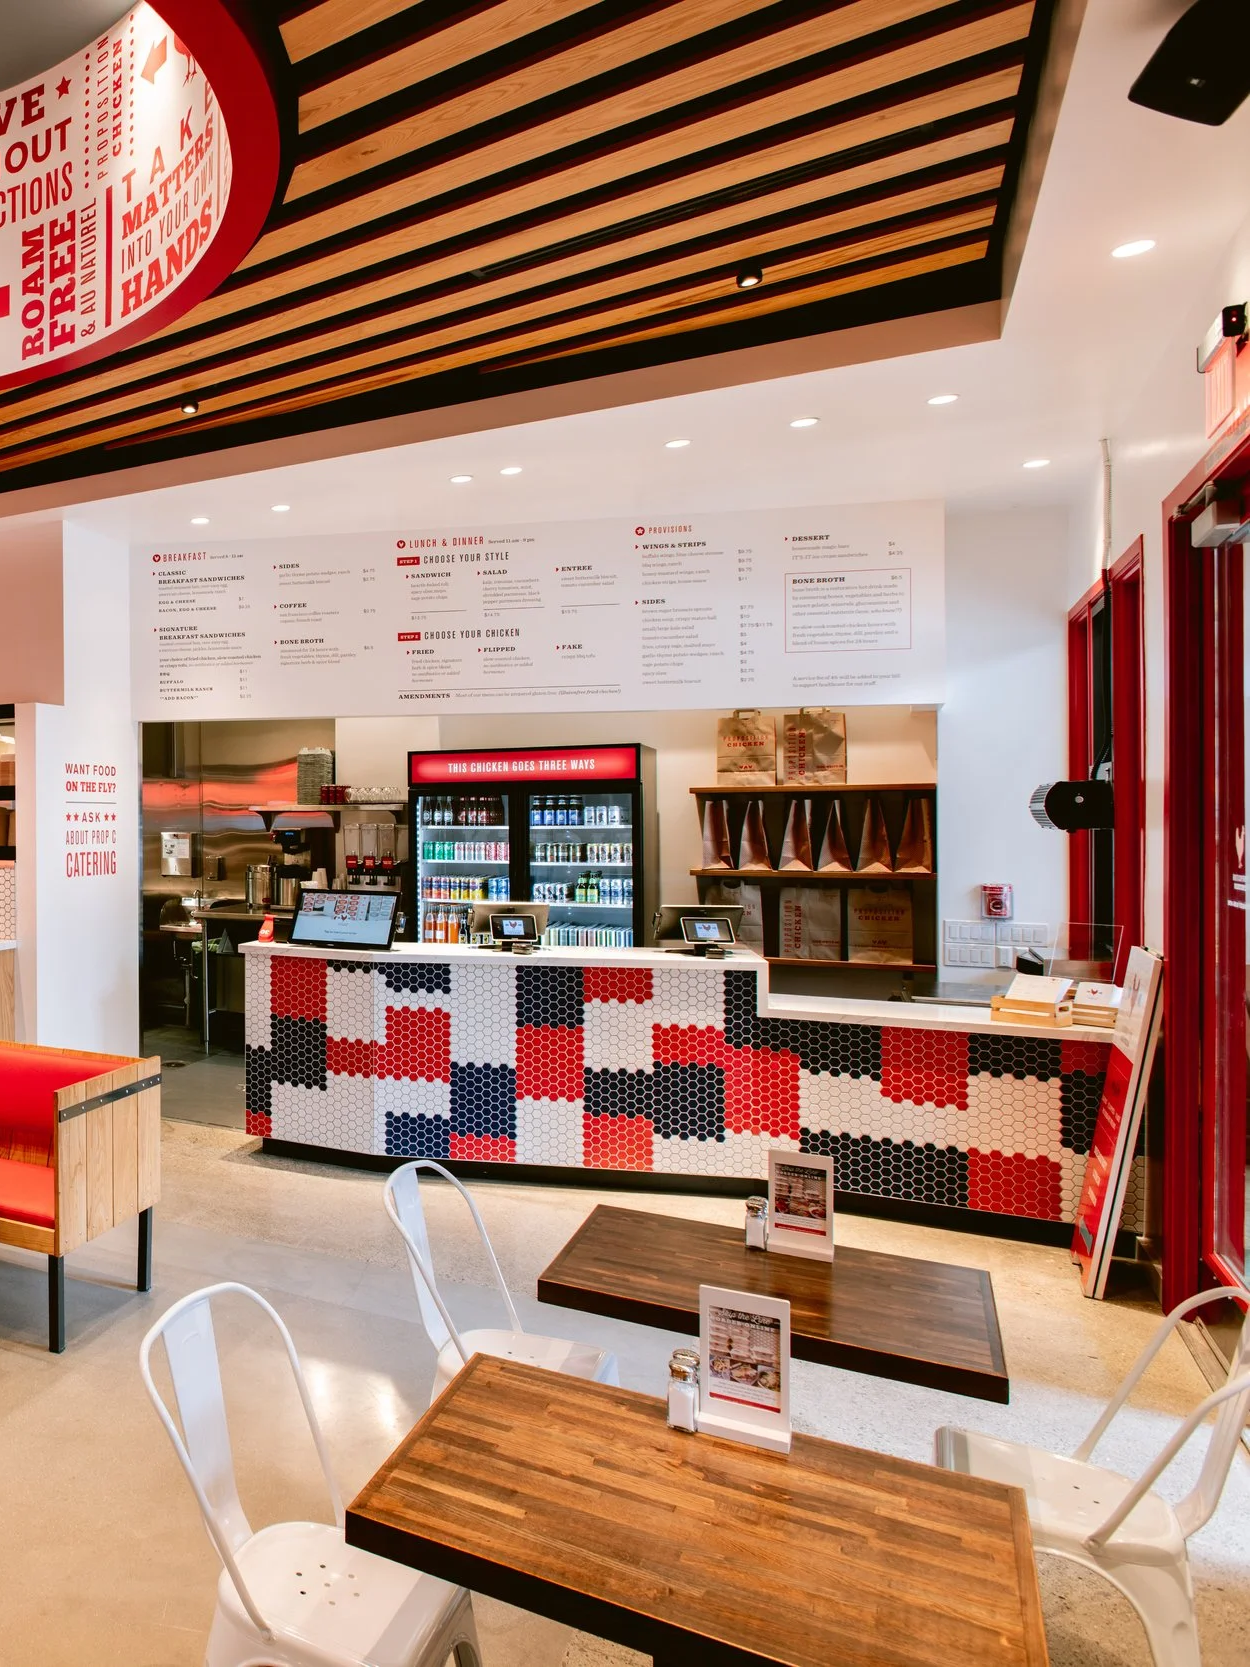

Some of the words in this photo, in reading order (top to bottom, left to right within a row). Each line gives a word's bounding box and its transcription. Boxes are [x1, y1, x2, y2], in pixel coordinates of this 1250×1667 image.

[111, 38, 123, 158] CHICKEN
[96, 35, 110, 181] PROPOSITION
[121, 112, 214, 241] MATTERS
[120, 227, 153, 275] INTO
[159, 188, 191, 244] YOUR
[80, 198, 97, 287] NATUREL
[120, 190, 212, 319] HANDS
[48, 210, 76, 352] FREE
[21, 223, 45, 361] ROAM
[80, 289, 97, 316] AU
[80, 320, 97, 338] &
[648, 525, 693, 535] PROVISIONS
[409, 538, 437, 549] LUNCH
[441, 537, 448, 547] &
[452, 535, 485, 547] DINNER
[163, 551, 207, 563] BREAKFAST
[423, 553, 456, 565] CHOOSE
[459, 552, 481, 563] YOUR
[484, 550, 510, 562] STYLE
[158, 577, 198, 585] BREAKFAST
[411, 571, 452, 579] SANDWICH
[199, 631, 247, 639] SANDWICHES
[424, 630, 457, 641] CHOOSE
[460, 629, 482, 640] YOUR
[485, 627, 521, 638] CHICKEN
[397, 692, 452, 700] AMENDMENTS
[797, 731, 806, 776] CHICKEN
[65, 763, 91, 776] WANT
[93, 764, 117, 777] FOOD
[447, 762, 467, 773] THIS
[470, 760, 509, 773] CHICKEN
[511, 760, 536, 772] GOES
[539, 759, 568, 771] THREE
[570, 757, 596, 770] WAYS
[65, 780, 79, 792] ON
[80, 781, 97, 793] THE
[98, 781, 117, 793] FLY?
[81, 811, 102, 823] ASK
[65, 829, 90, 846] ABOUT
[91, 829, 110, 845] PROP
[111, 829, 117, 844] C
[66, 850, 117, 878] CATERING
[857, 914, 900, 922] CHICKEN
[794, 904, 802, 949] CHICKEN
[744, 1321, 775, 1333] ONLINE
